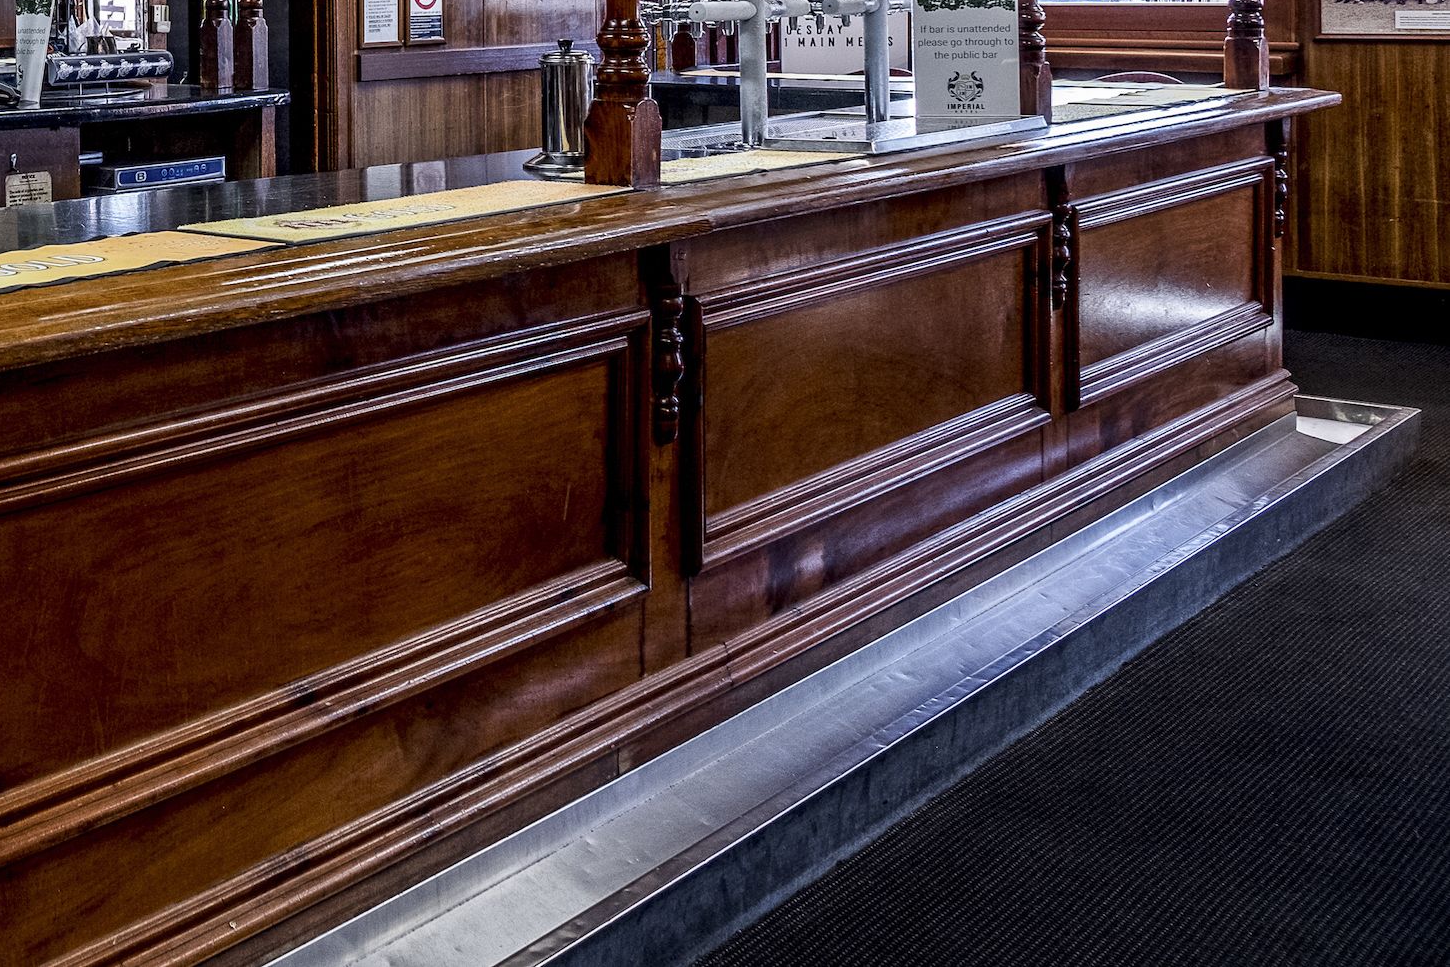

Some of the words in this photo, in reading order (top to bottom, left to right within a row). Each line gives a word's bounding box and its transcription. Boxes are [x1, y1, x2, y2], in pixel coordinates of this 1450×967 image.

[920, 25, 927, 33] If
[947, 25, 955, 33] is
[957, 24, 1011, 33] unattended
[798, 37, 835, 47] MAIN
[846, 36, 894, 47] MES
[918, 38, 948, 48] please
[950, 40, 962, 48] go
[964, 38, 1002, 48] through
[1004, 38, 1014, 46] to
[934, 51, 950, 60] the
[952, 50, 980, 60] public
[982, 50, 998, 59] bar
